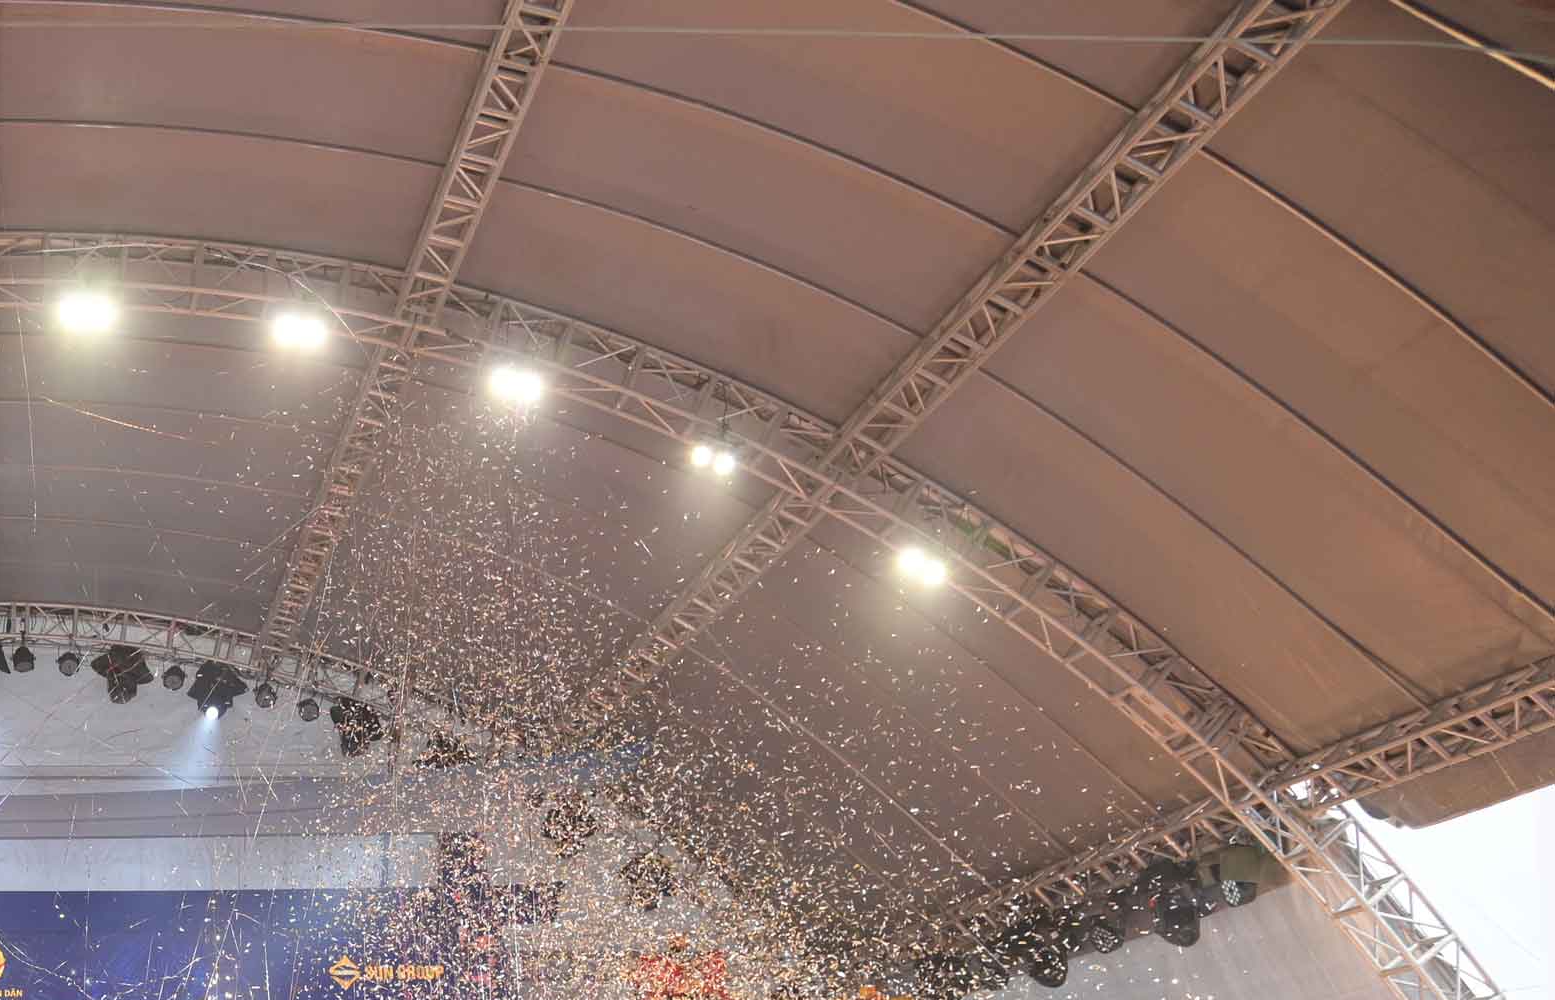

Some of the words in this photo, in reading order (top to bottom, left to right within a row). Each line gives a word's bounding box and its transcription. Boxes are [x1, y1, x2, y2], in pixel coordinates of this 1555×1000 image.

[365, 964, 394, 981] SUN
[397, 964, 444, 981] GROUP
[4, 988, 23, 998] DÂN
